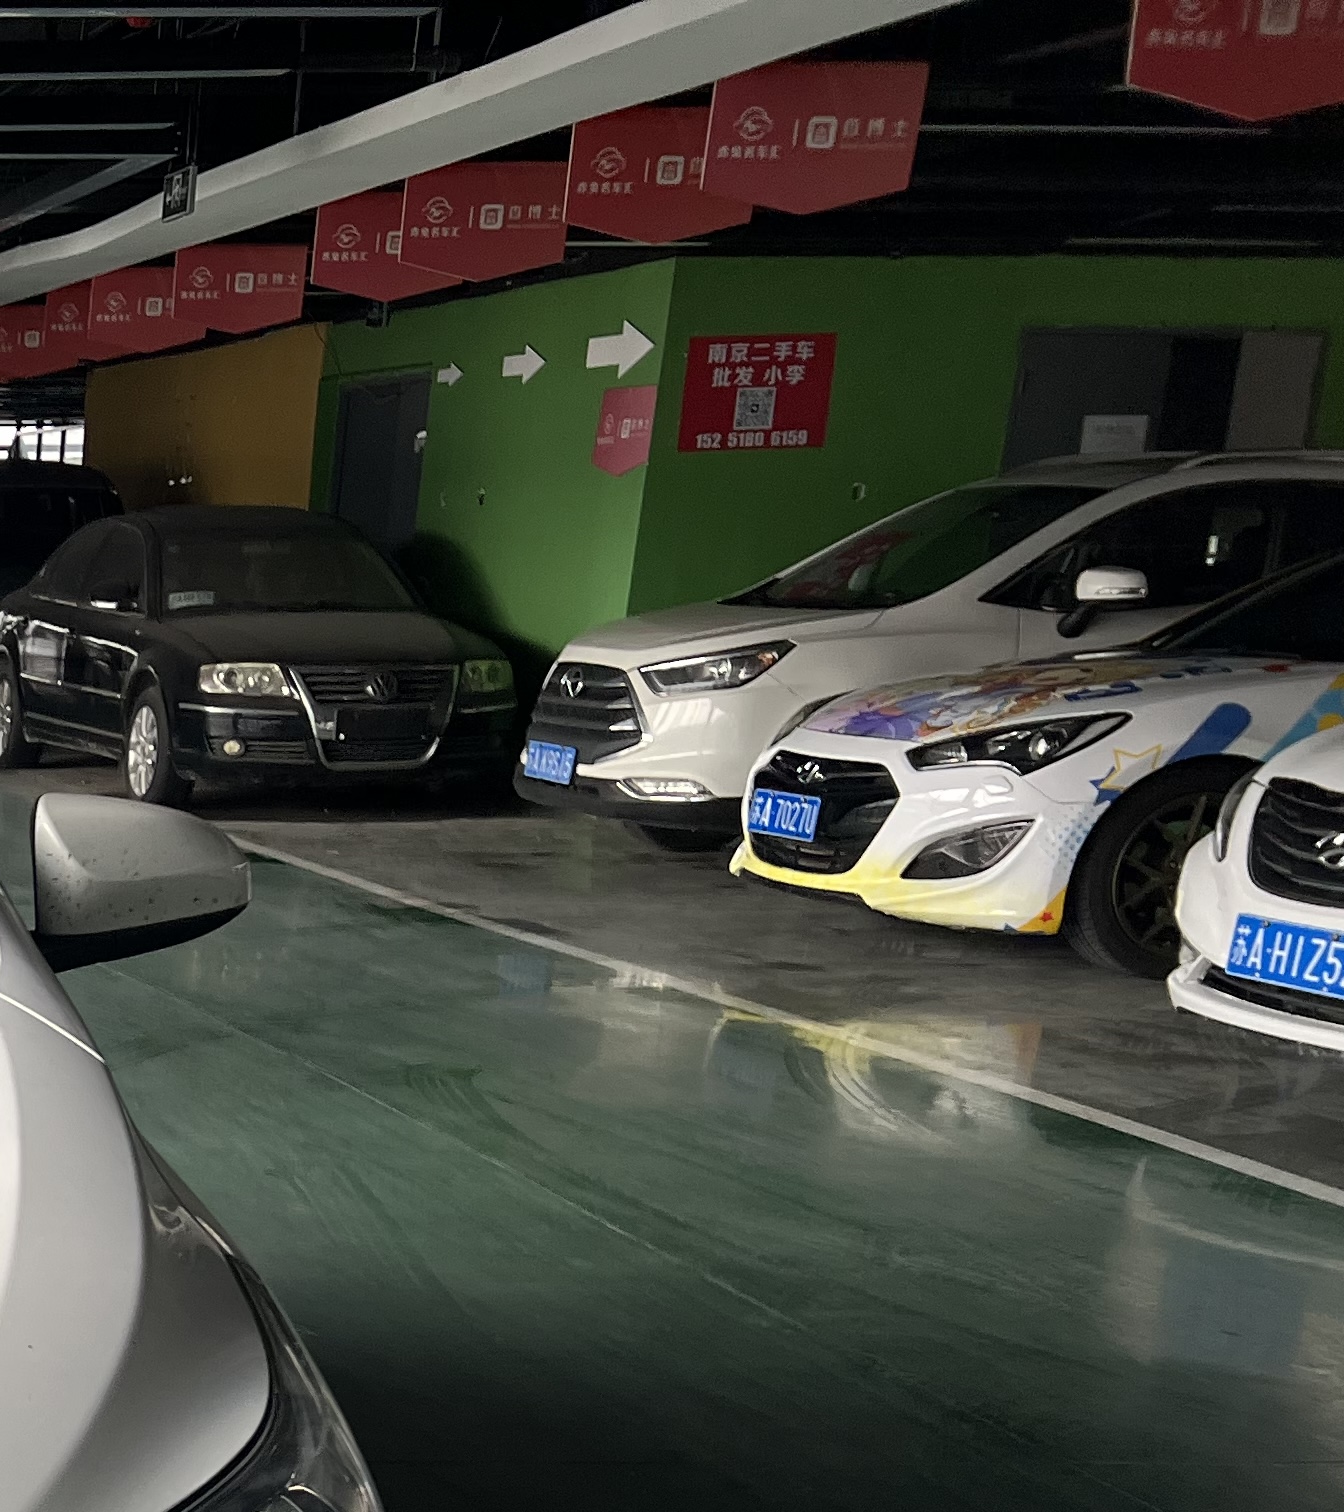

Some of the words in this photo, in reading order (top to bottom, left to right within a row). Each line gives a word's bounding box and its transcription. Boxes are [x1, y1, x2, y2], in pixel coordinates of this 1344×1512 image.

[707, 341, 816, 364] 南京二手车
[711, 366, 755, 388] 批发
[696, 432, 722, 449] 152
[770, 429, 809, 447] 6159
[1230, 923, 1344, 988] 苏A·H1Z5
